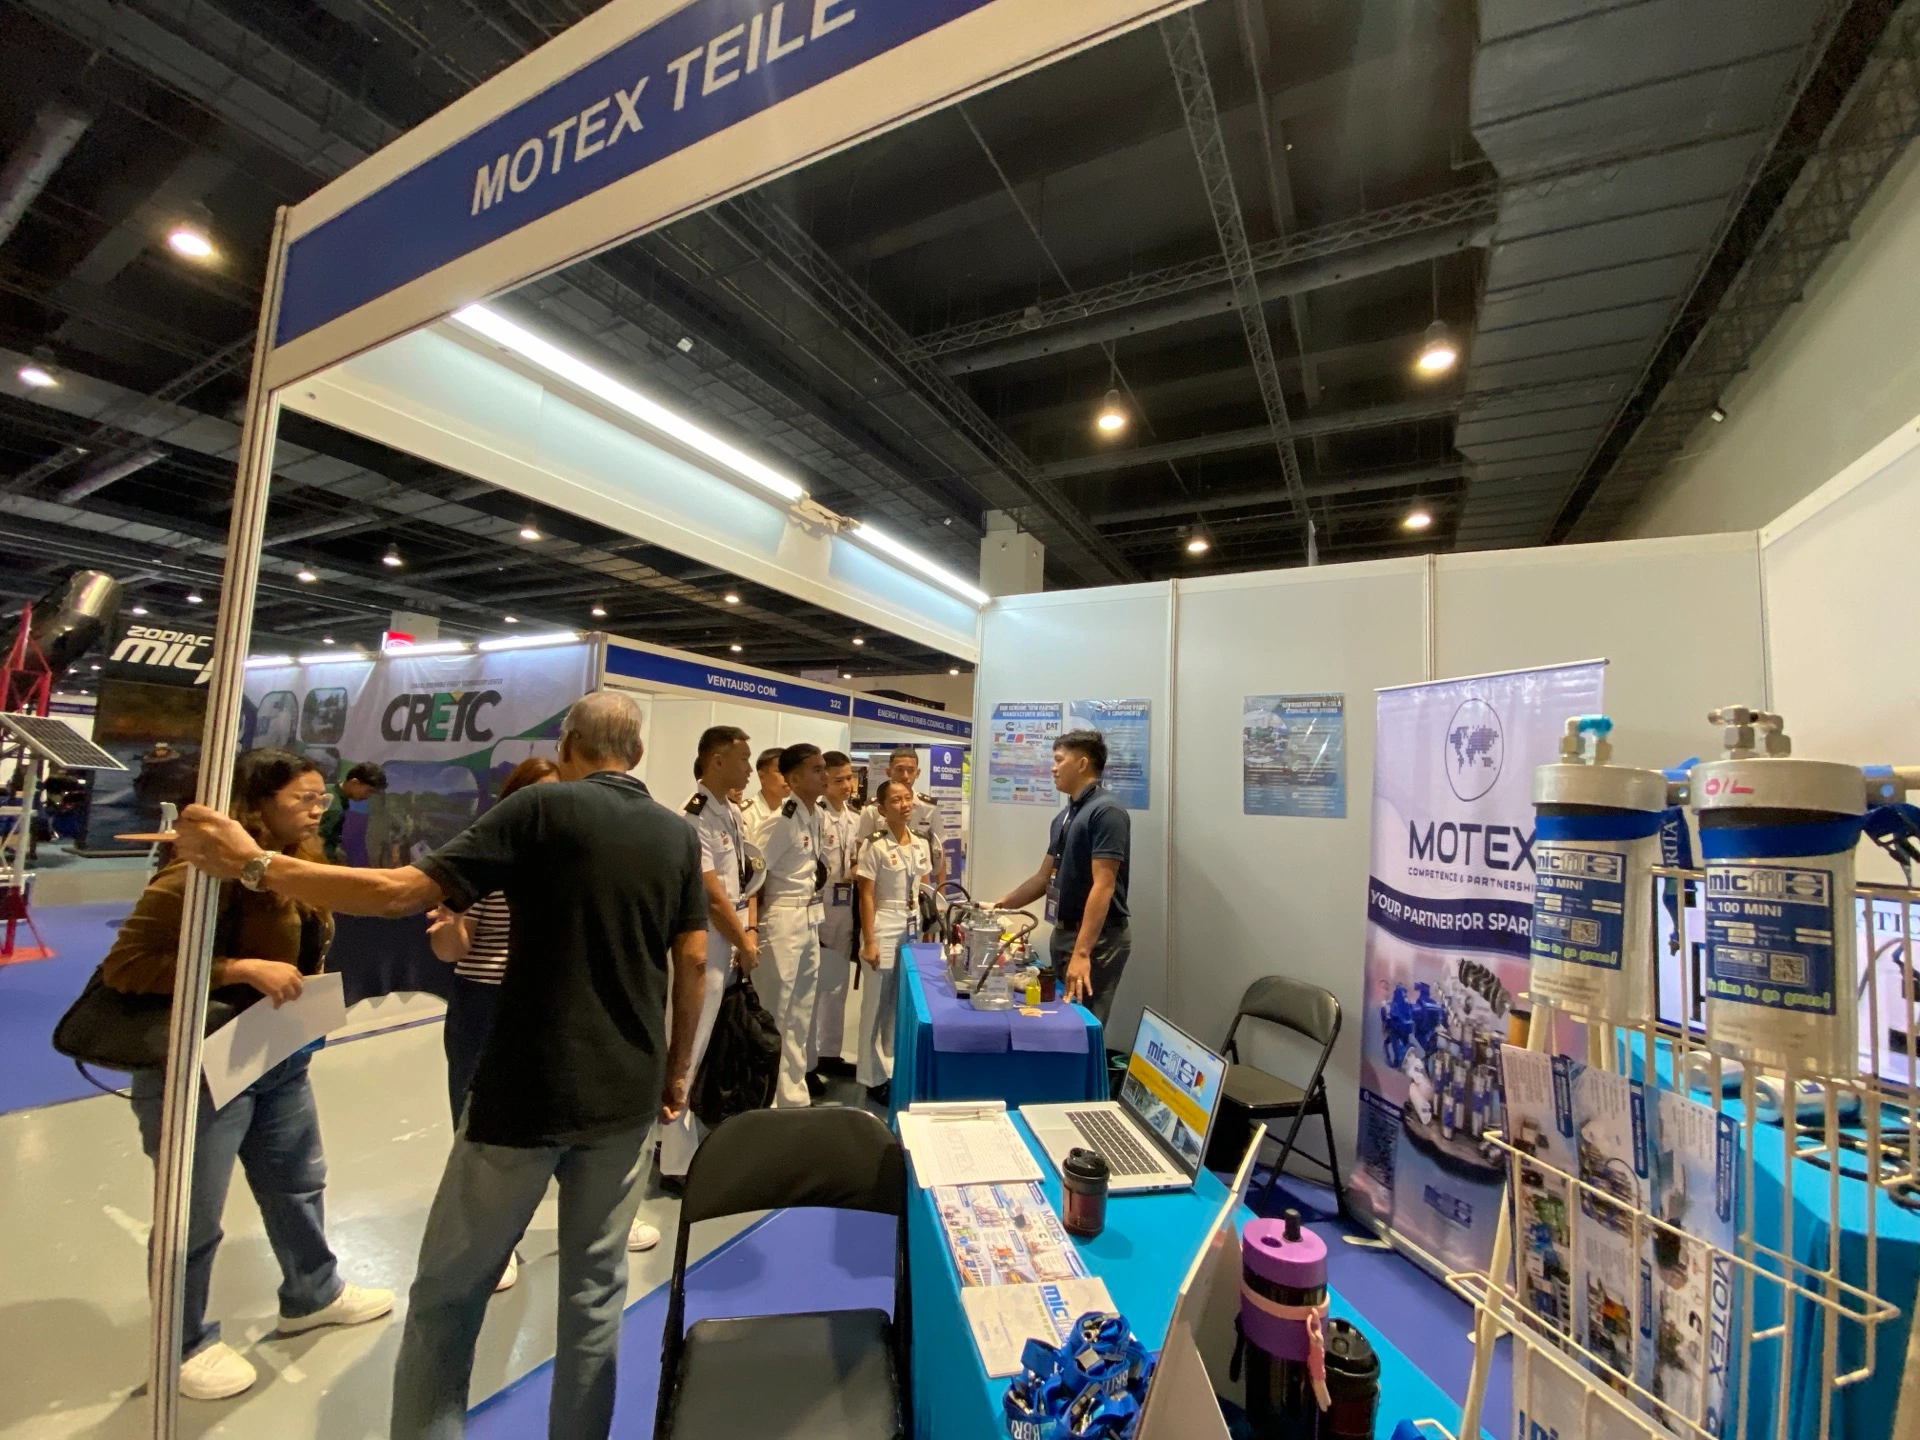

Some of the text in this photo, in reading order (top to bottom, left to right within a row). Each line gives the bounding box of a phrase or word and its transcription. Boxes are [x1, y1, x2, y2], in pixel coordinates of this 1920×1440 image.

[471, 0, 855, 216] MOTEX TEILE
[127, 625, 214, 647] ZODIAC
[706, 674, 842, 709] VENTAUSO COM. 322
[381, 690, 502, 742] CRETC
[877, 708, 899, 720] ENERGY
[899, 713, 927, 726] INDUSTRIES
[926, 720, 945, 730] COUNCIL
[1705, 778, 1754, 795] OIL
[1409, 820, 1537, 873] MOTEX
[1663, 820, 1680, 868] RITA
[1408, 867, 1458, 882] COMPETENCE
[1556, 878, 1583, 890] MINI
[1370, 889, 1401, 919] YOUR
[1403, 905, 1454, 930] PARTNER
[1455, 912, 1484, 931] FOR
[1718, 901, 1740, 913] 100
[1744, 903, 1782, 917] MINI
[1744, 984, 1759, 998] to
[1761, 989, 1781, 1003] go
[1784, 992, 1831, 1009] green!
[1041, 1209, 1069, 1245] MOTEX
[1709, 1254, 1730, 1387] MOTEX
